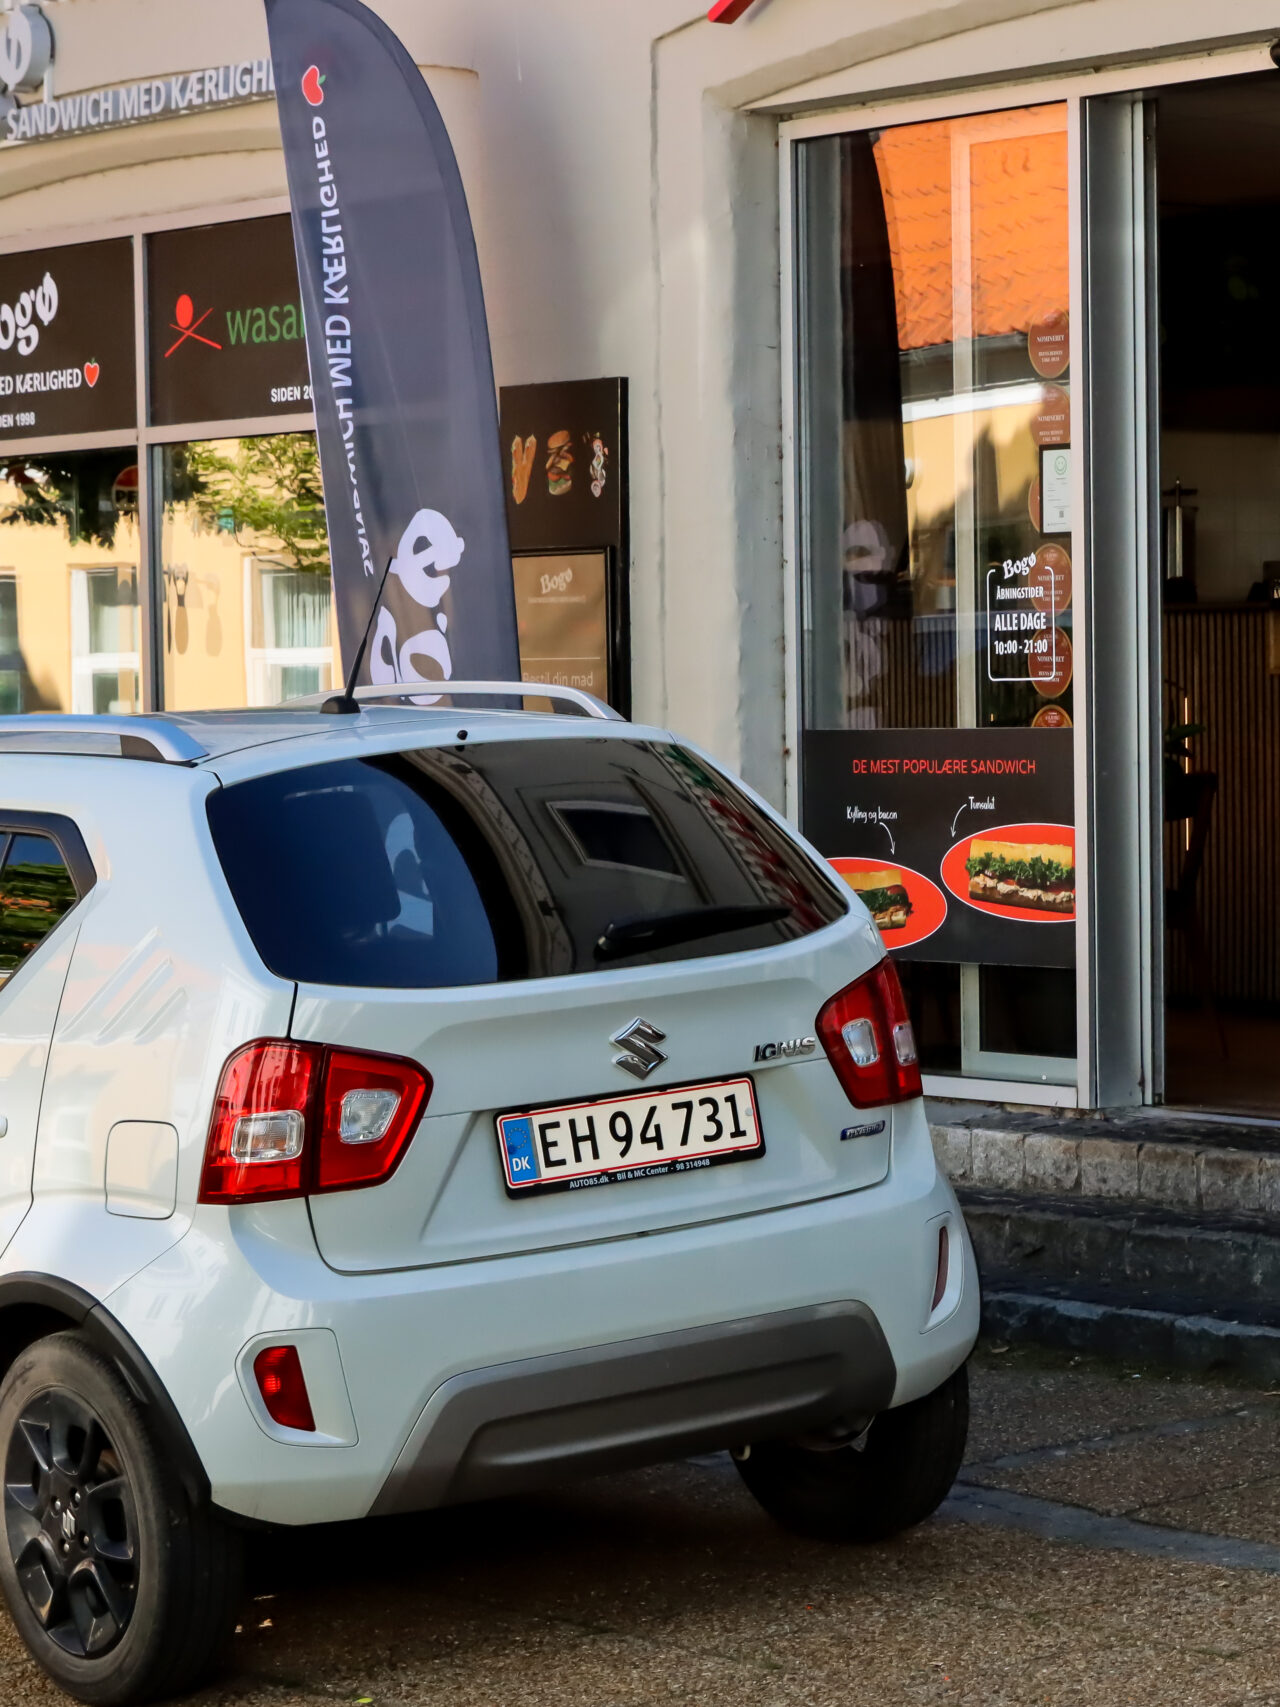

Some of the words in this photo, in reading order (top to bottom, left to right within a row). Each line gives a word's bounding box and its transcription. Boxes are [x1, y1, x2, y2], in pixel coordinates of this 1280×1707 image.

[6, 90, 113, 140] SANDWICH
[118, 80, 166, 120] MED
[16, 367, 82, 394] KÆRLIGHED
[271, 386, 301, 403] SIDEN
[15, 411, 35, 426] 1998
[996, 586, 1044, 600] ÅBNINGSTIDER
[994, 613, 1019, 631] ALLE
[1020, 612, 1047, 630] DAGE
[993, 640, 1018, 655] 10:00
[1023, 638, 1048, 654] 21:00
[571, 671, 594, 687] mad
[852, 759, 868, 774] DE
[870, 759, 900, 774] MEST
[903, 759, 968, 774] POPULÆRE
[971, 759, 1036, 774] SANDWICH
[968, 796, 995, 810] Tunsalat
[846, 805, 868, 823] Kylling
[868, 811, 877, 824] og
[878, 805, 898, 820] bacon
[753, 1036, 816, 1062] IGNIS
[512, 1156, 531, 1172] DK
[570, 1175, 609, 1189] AUTO85.dk
[617, 1172, 626, 1181] Bil
[627, 1171, 633, 1179] &
[634, 1169, 645, 1178] MC
[647, 1165, 668, 1175] Center
